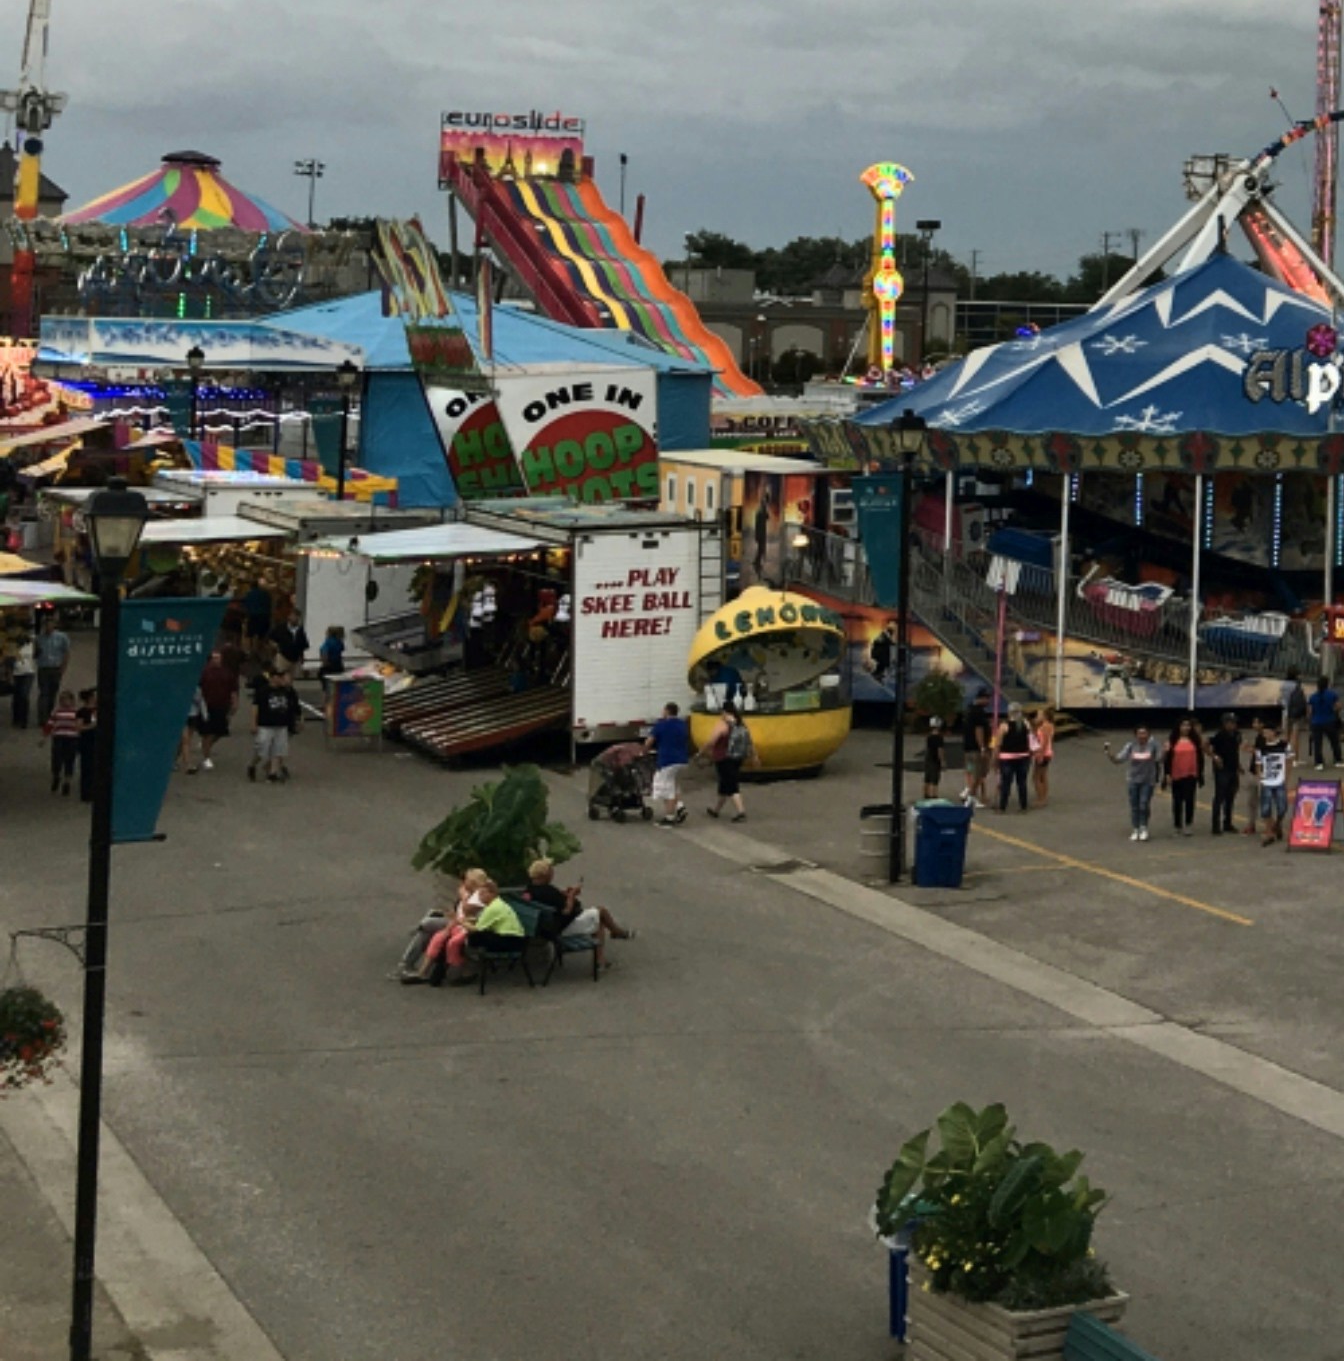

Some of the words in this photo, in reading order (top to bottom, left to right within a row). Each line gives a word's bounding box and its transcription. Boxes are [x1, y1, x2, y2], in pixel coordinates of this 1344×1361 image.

[446, 109, 579, 132] euroslide
[523, 382, 594, 422] ONE
[605, 384, 643, 411] IN
[521, 423, 644, 488] HOOP
[581, 594, 635, 615] SKEE
[641, 590, 693, 612] BALL
[601, 616, 672, 639] HERE!
